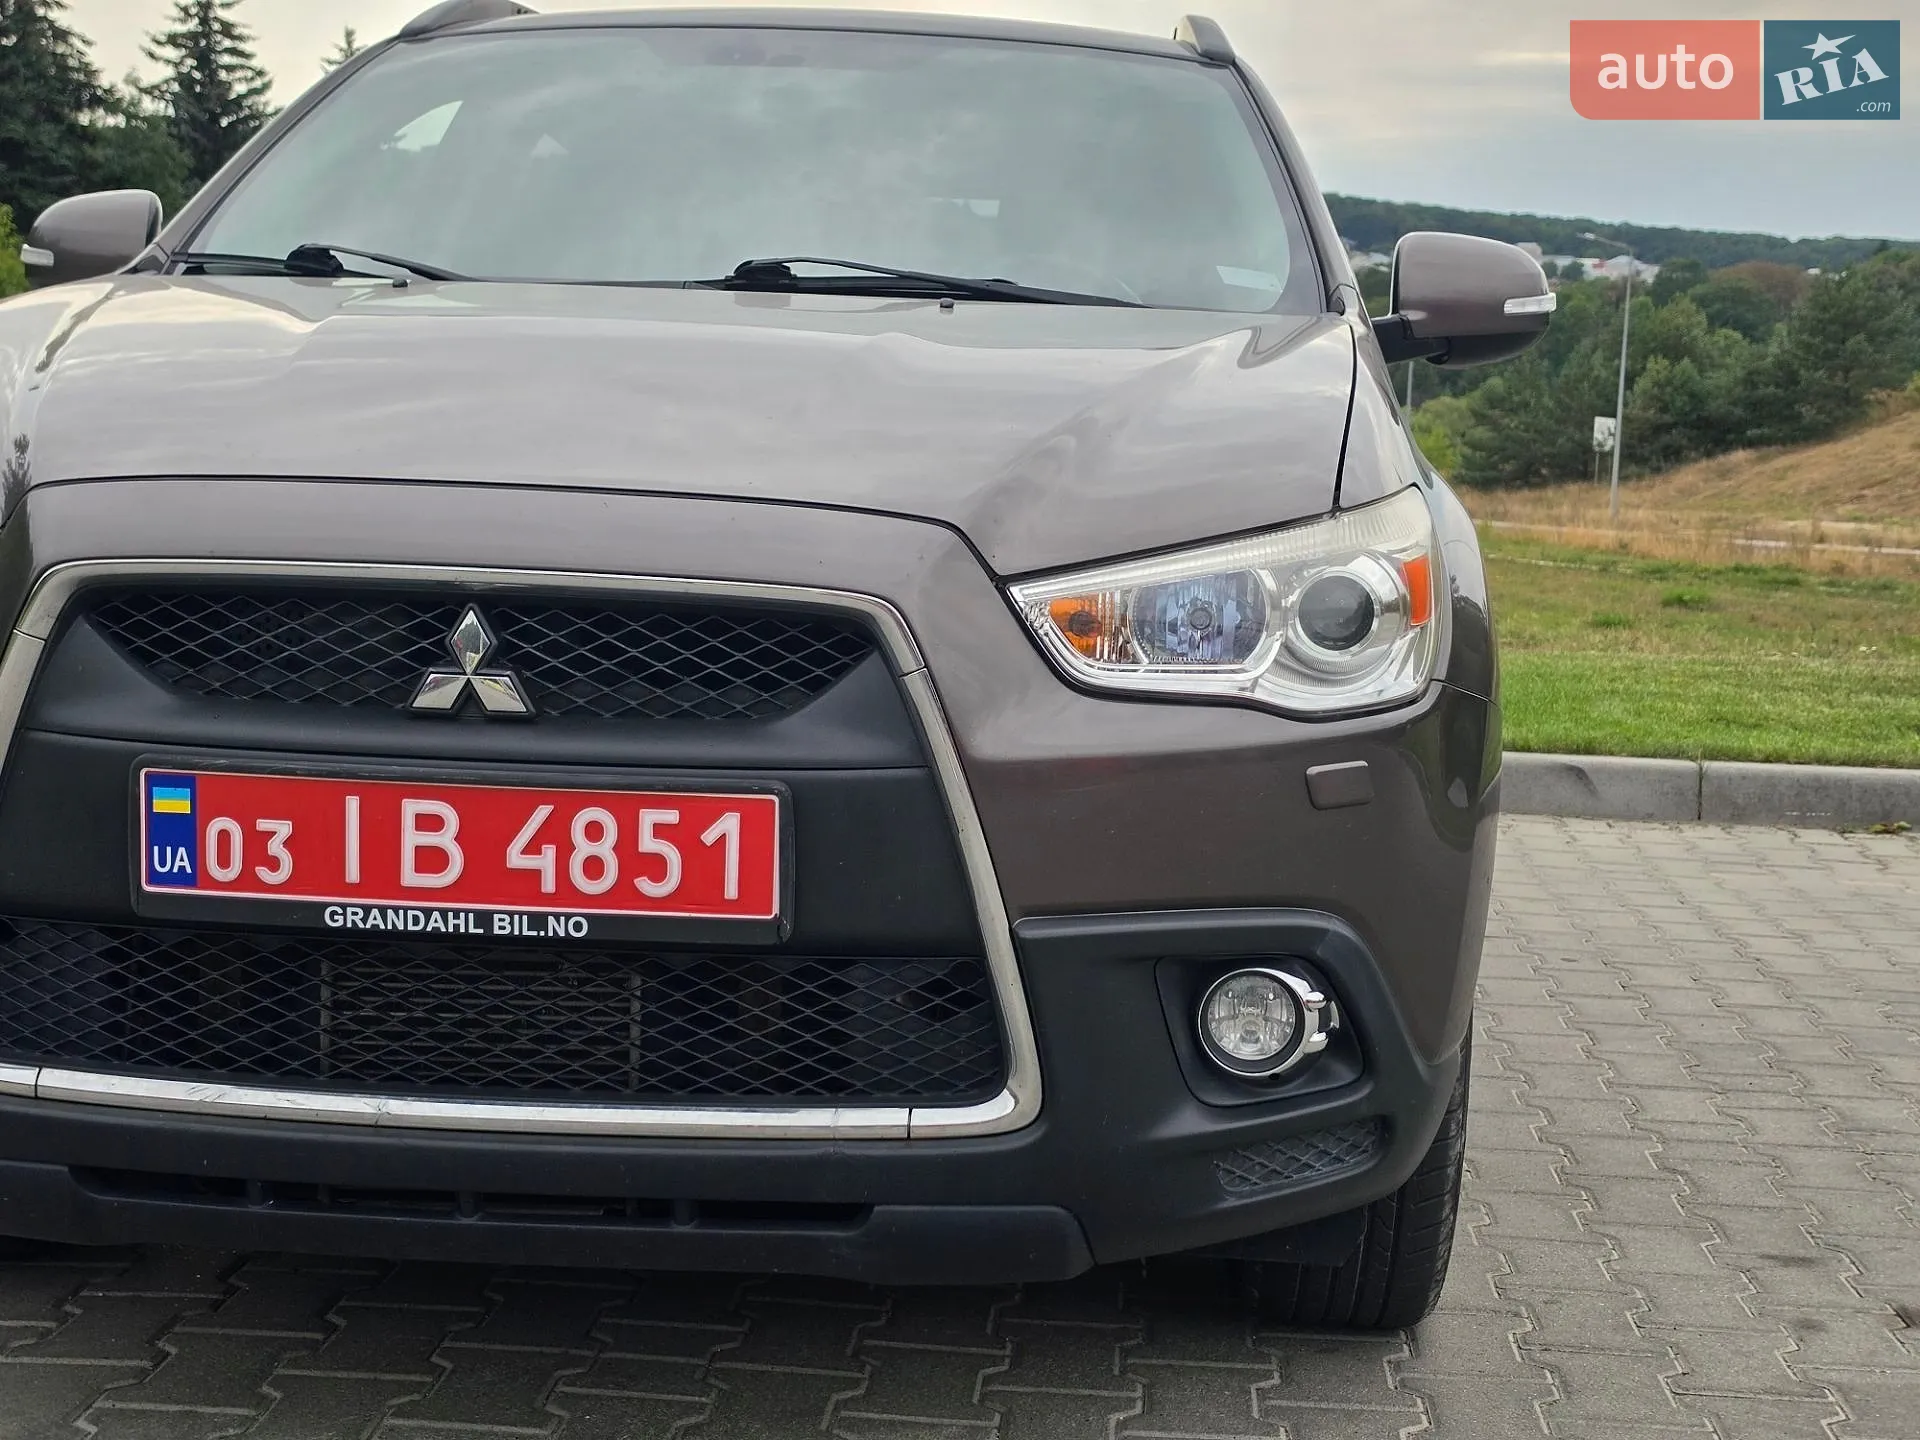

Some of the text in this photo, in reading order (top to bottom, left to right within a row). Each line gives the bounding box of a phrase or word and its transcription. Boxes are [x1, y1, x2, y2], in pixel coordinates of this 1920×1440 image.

[153, 846, 193, 874] UA
[204, 816, 294, 886] 03
[506, 804, 742, 900] 4851
[323, 905, 590, 939] GRANDAHL BIL.NO
